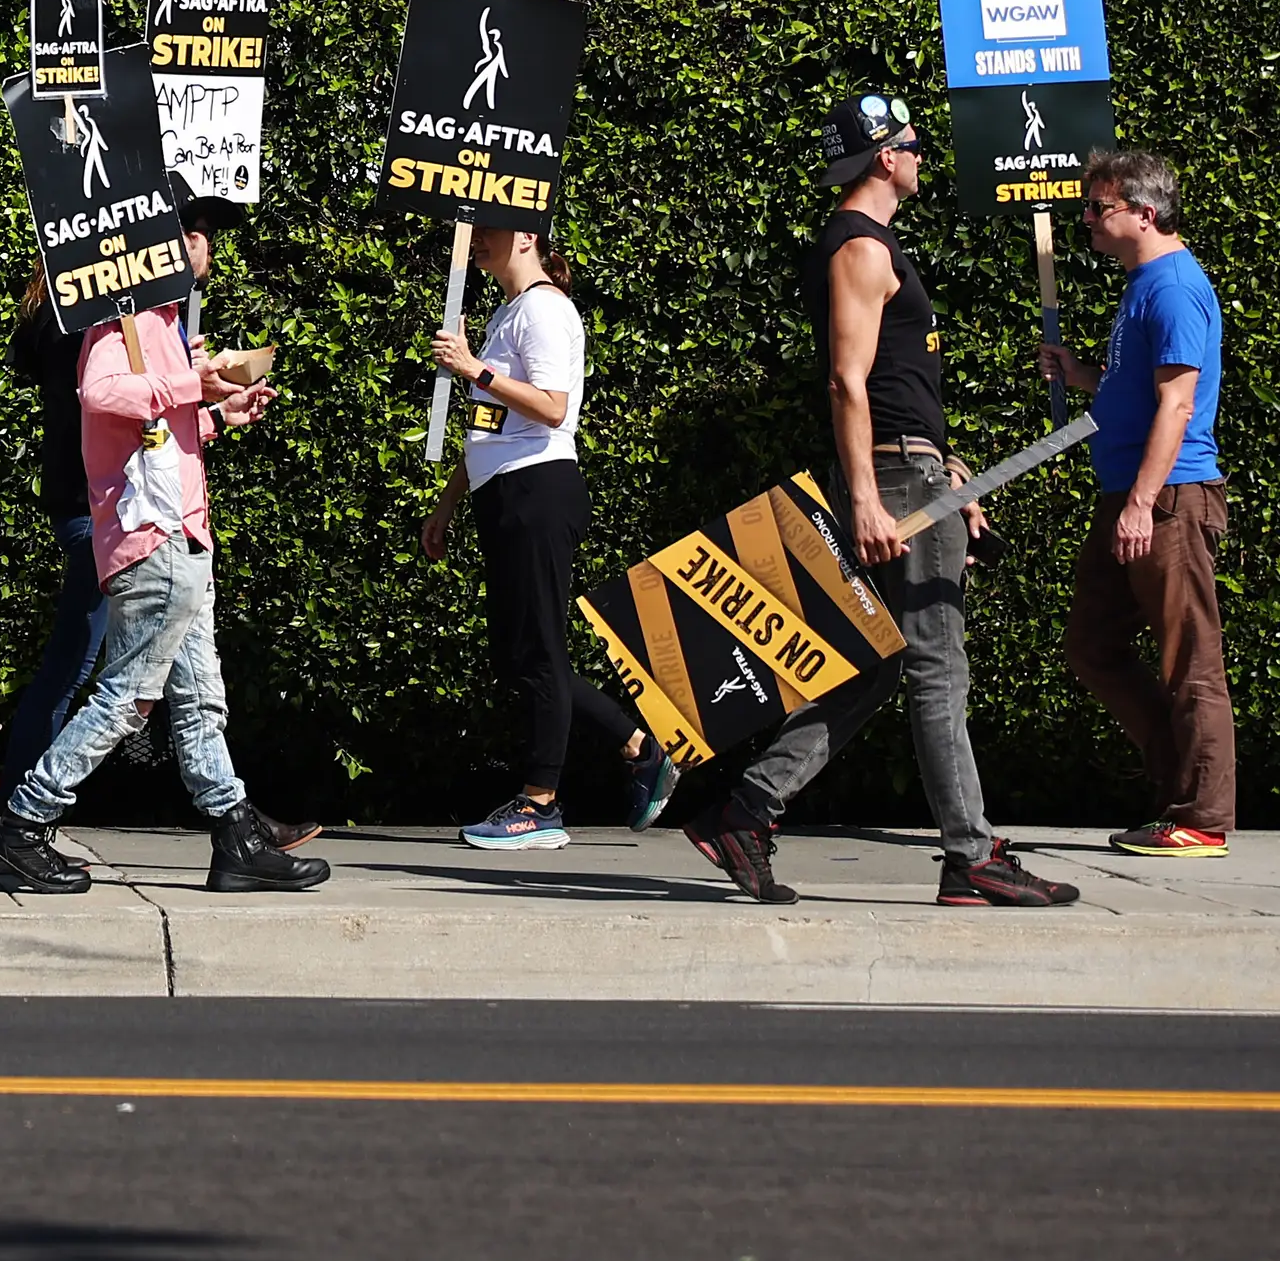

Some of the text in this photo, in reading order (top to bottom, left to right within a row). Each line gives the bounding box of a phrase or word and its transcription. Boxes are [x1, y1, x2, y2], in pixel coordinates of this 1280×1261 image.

[986, 4, 1059, 23] WGAW
[202, 17, 225, 34] ON
[60, 57, 74, 66] ON
[151, 34, 263, 68] STRIKE!
[975, 46, 1081, 76] STANDS WITH
[35, 66, 99, 84] STRIKE!
[156, 82, 239, 130] AMPTP
[457, 149, 491, 169] ON
[388, 157, 551, 212] STRIKE!
[1029, 170, 1047, 182] ON
[996, 180, 1082, 203] STRIKE!
[100, 234, 127, 257] ON
[55, 238, 185, 308] STRIKE!
[676, 545, 826, 683] ON STRIKE
[506, 820, 537, 833] HOKA
